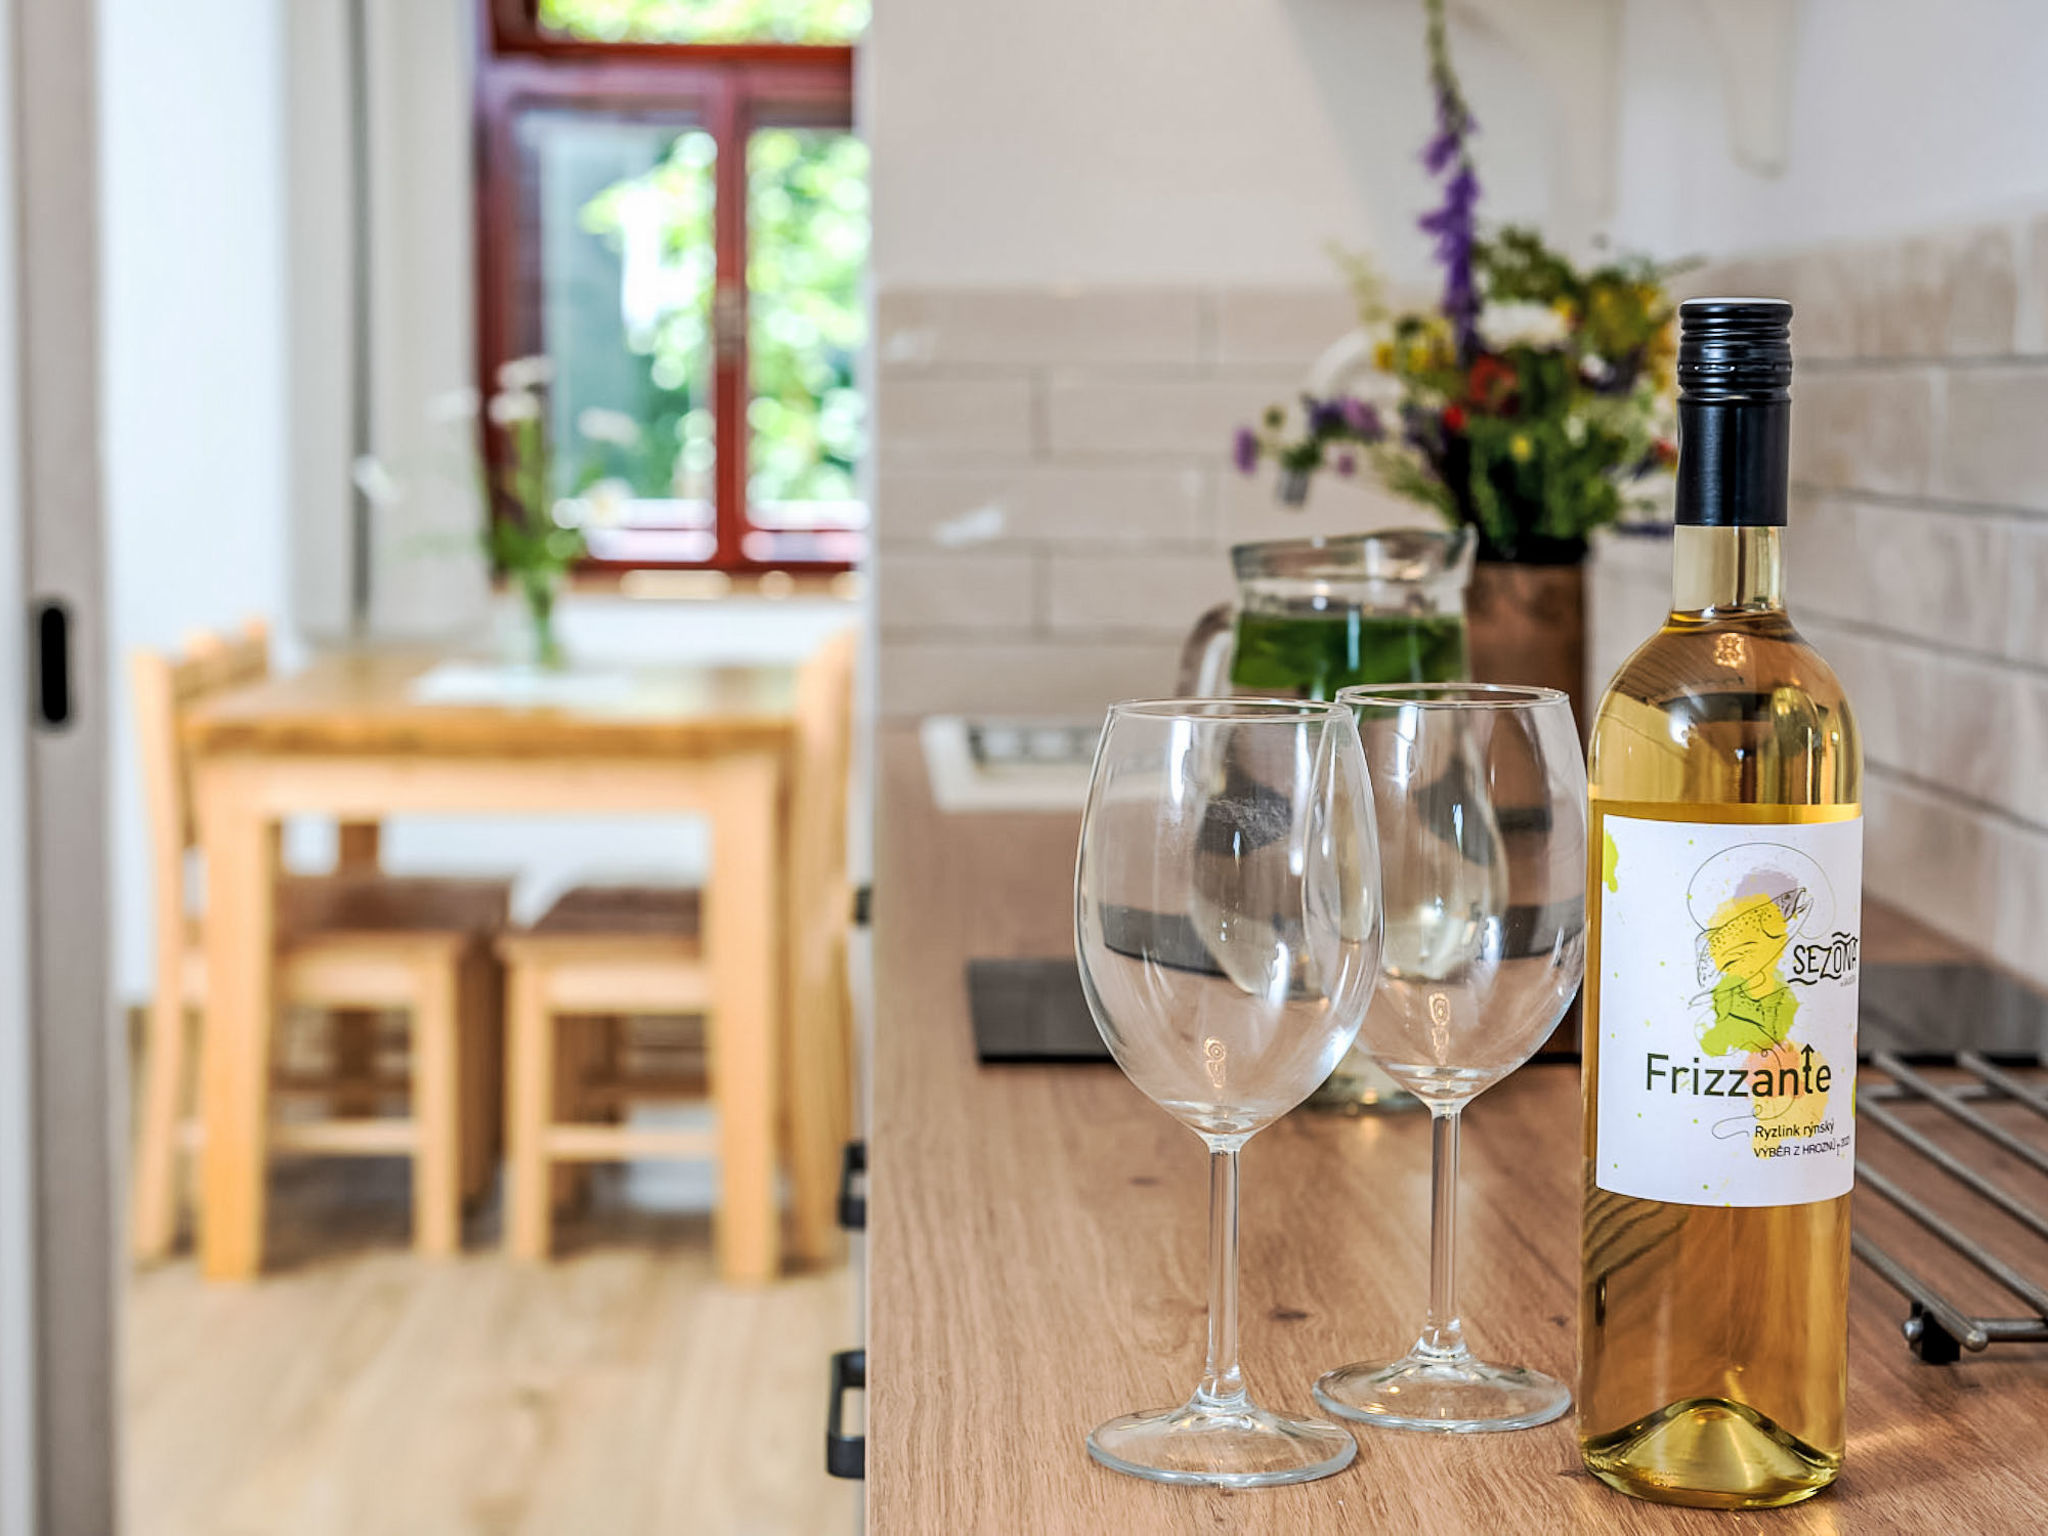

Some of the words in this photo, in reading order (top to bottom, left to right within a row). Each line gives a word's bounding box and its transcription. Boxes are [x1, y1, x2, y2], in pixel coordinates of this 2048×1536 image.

[1646, 1048, 1832, 1097] Frizzante
[1754, 1124, 1801, 1141] Ryzlink
[1793, 1146, 1800, 1156] Z
